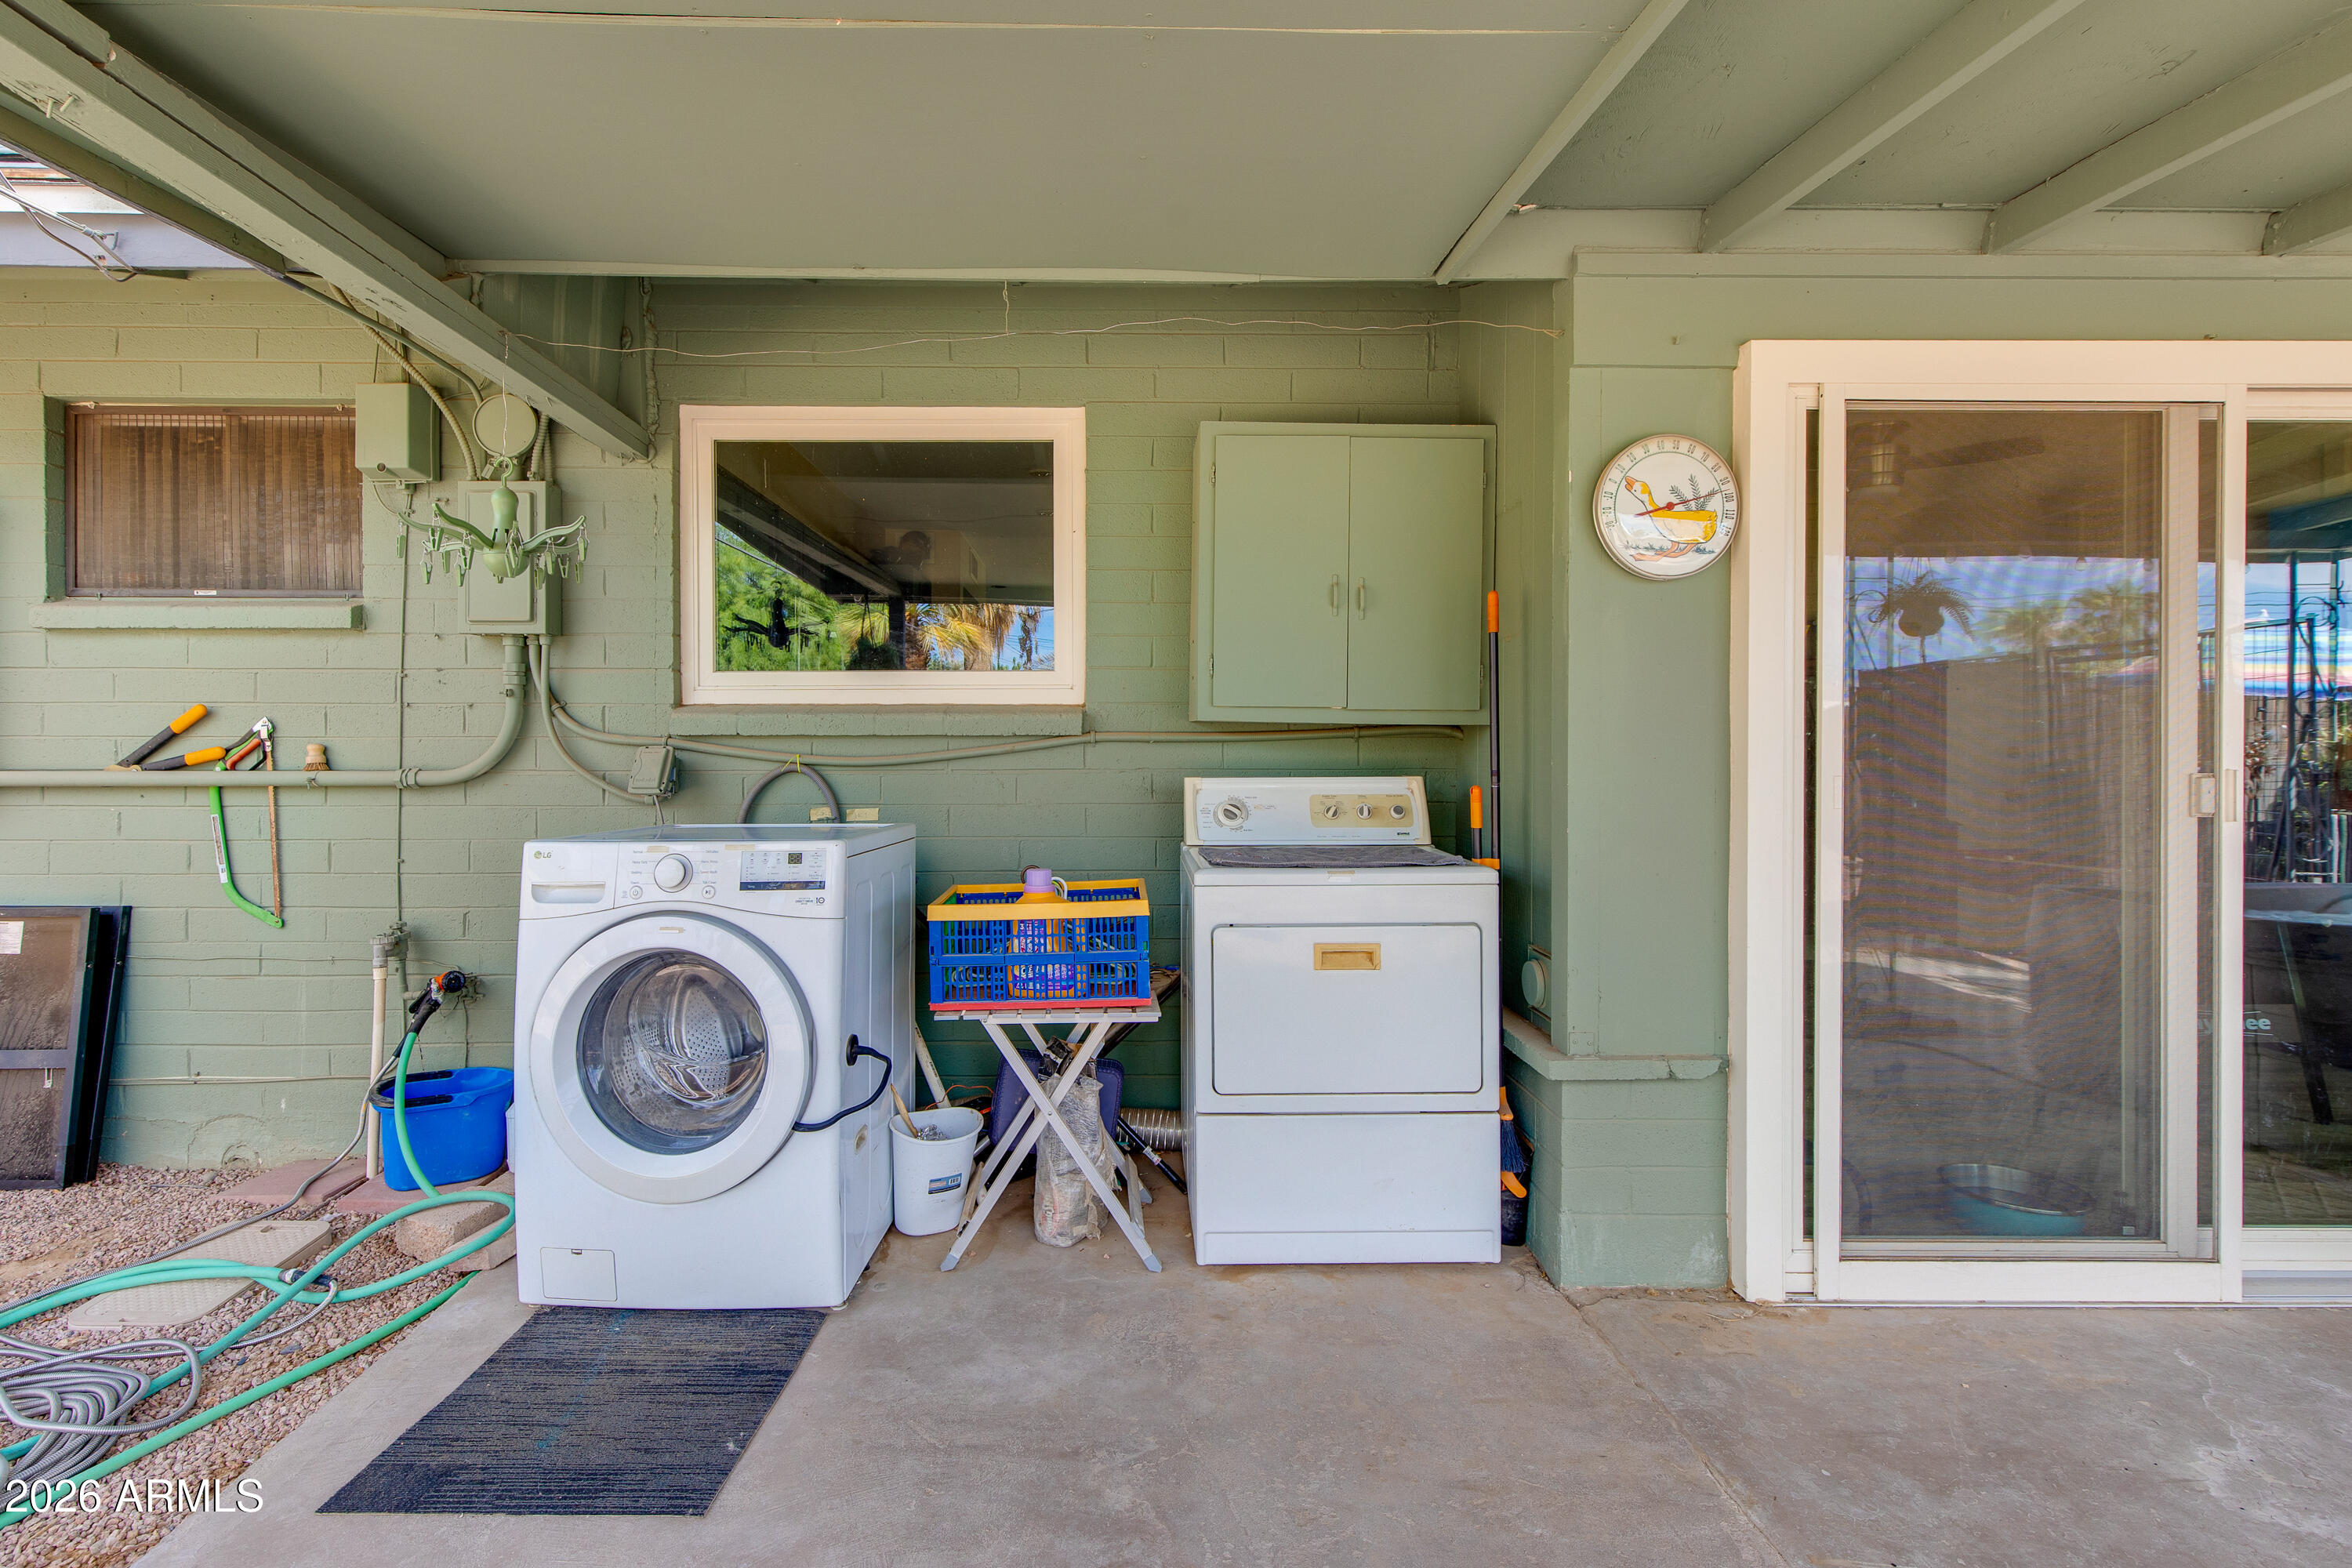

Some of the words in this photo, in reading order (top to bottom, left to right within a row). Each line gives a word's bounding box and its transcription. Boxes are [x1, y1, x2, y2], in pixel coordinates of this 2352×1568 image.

[1642, 443, 1650, 454] 30
[1657, 440, 1665, 450] 40
[1672, 440, 1680, 450] 50
[1687, 443, 1696, 454] 60
[1627, 452, 1636, 463] 20
[1700, 452, 1709, 462] 70
[1615, 463, 1625, 473] 10
[1711, 463, 1722, 473] 80
[1719, 476, 1730, 486] 90
[1725, 492, 1734, 503] 100
[1725, 509, 1735, 520] 110
[2243, 1018, 2271, 1030] ee
